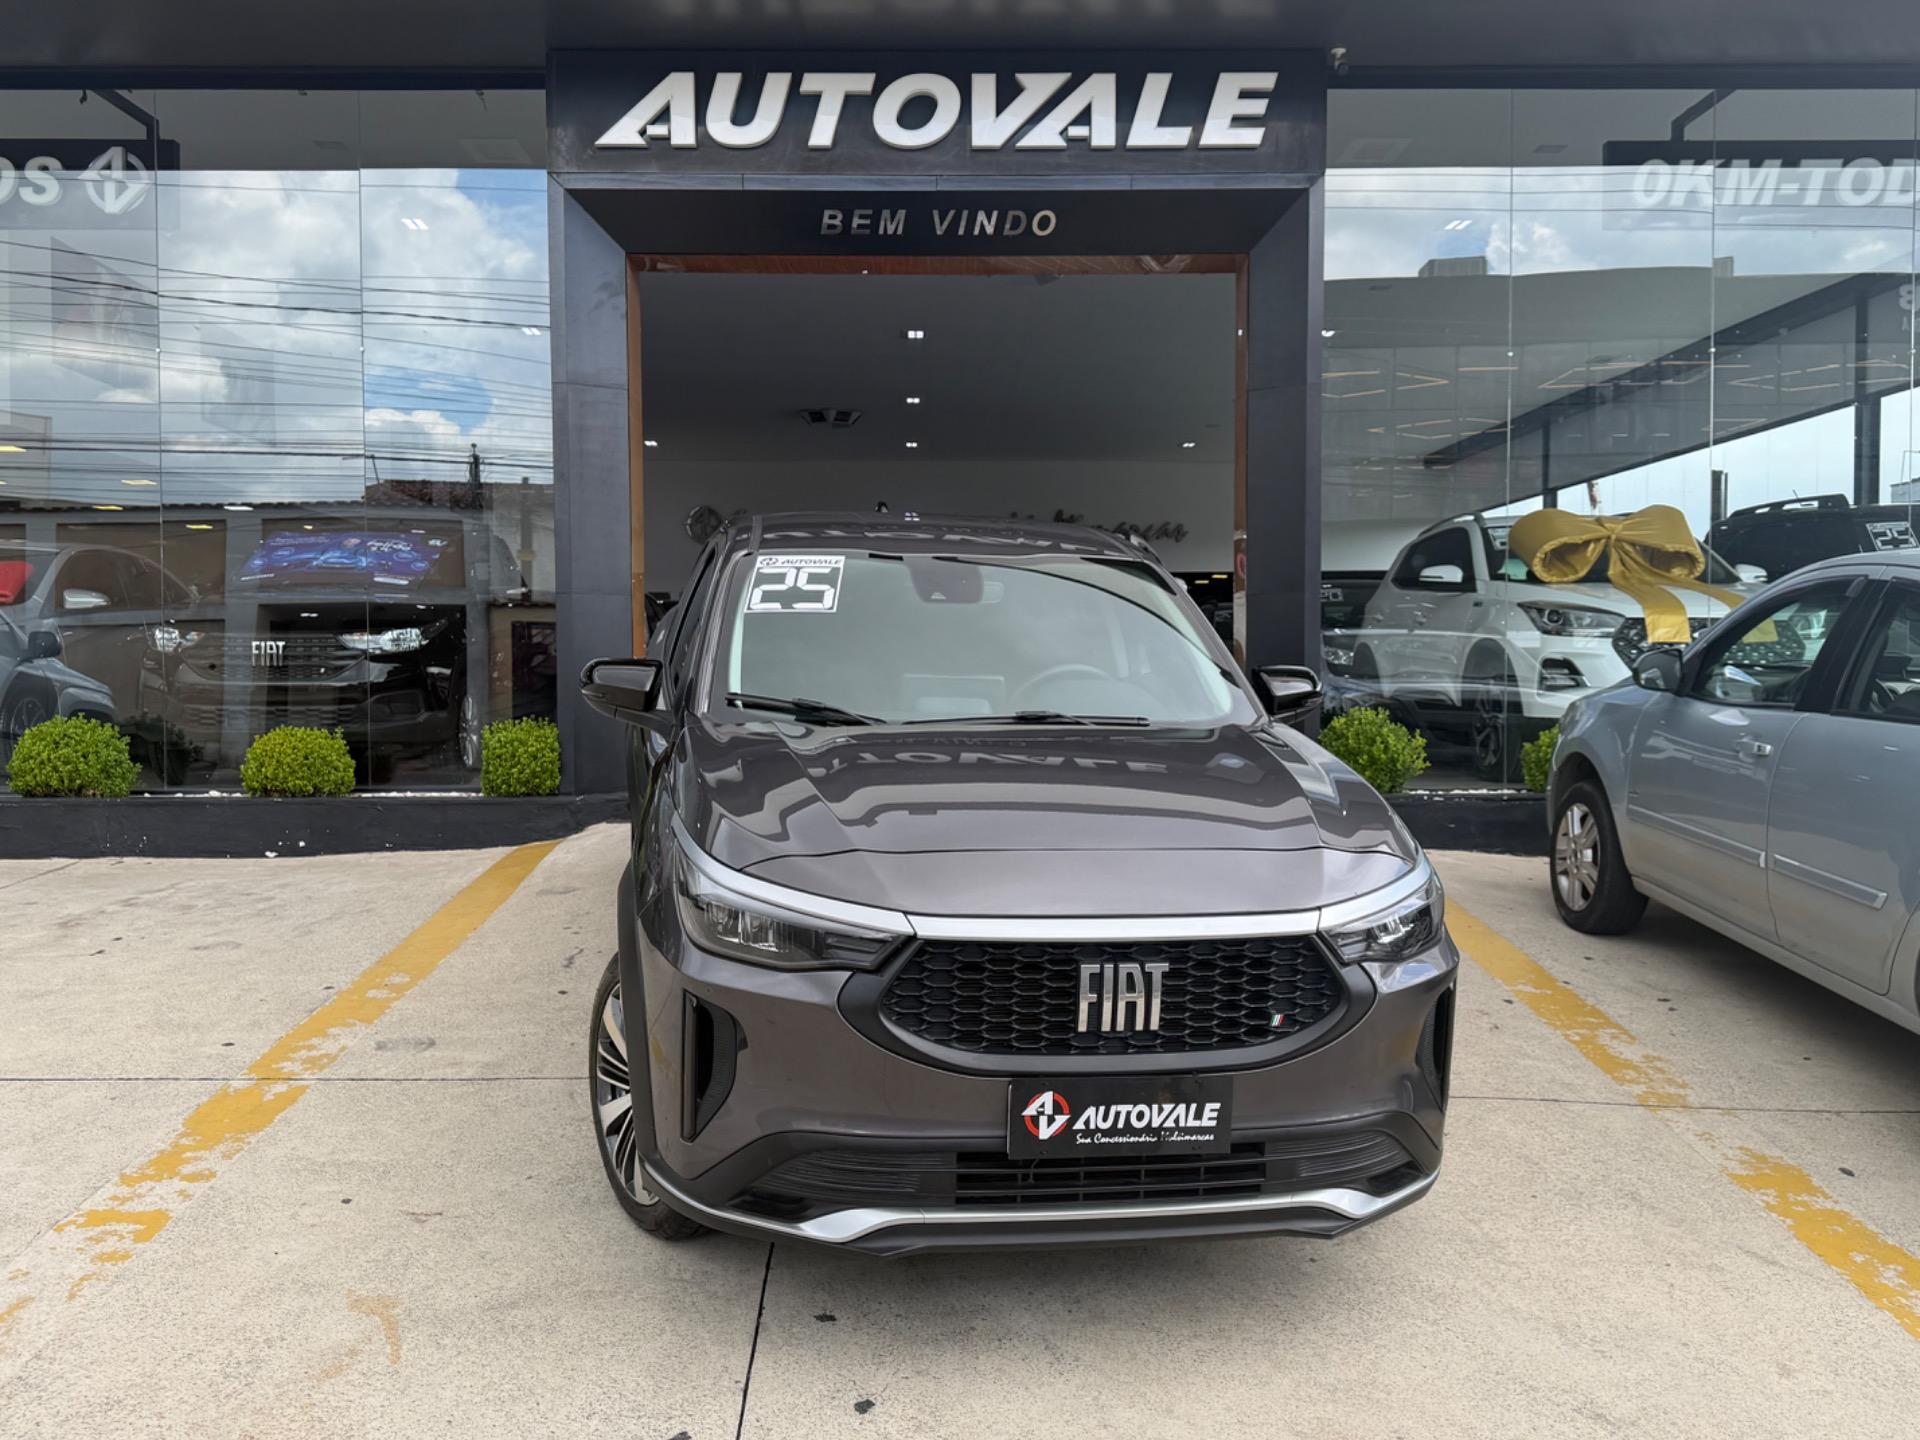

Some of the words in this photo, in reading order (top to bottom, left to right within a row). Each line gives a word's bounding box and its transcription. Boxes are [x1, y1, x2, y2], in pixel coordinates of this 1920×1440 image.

[595, 72, 1279, 150] AUTOVALE
[820, 209, 907, 236] BEM
[932, 209, 1057, 237] VINDO
[749, 566, 835, 610] 25
[251, 640, 287, 667] FIAT
[1077, 963, 1169, 1033] FIAT
[1072, 1102, 1221, 1130] AUTOVALE
[1076, 1132, 1092, 1144] Sua
